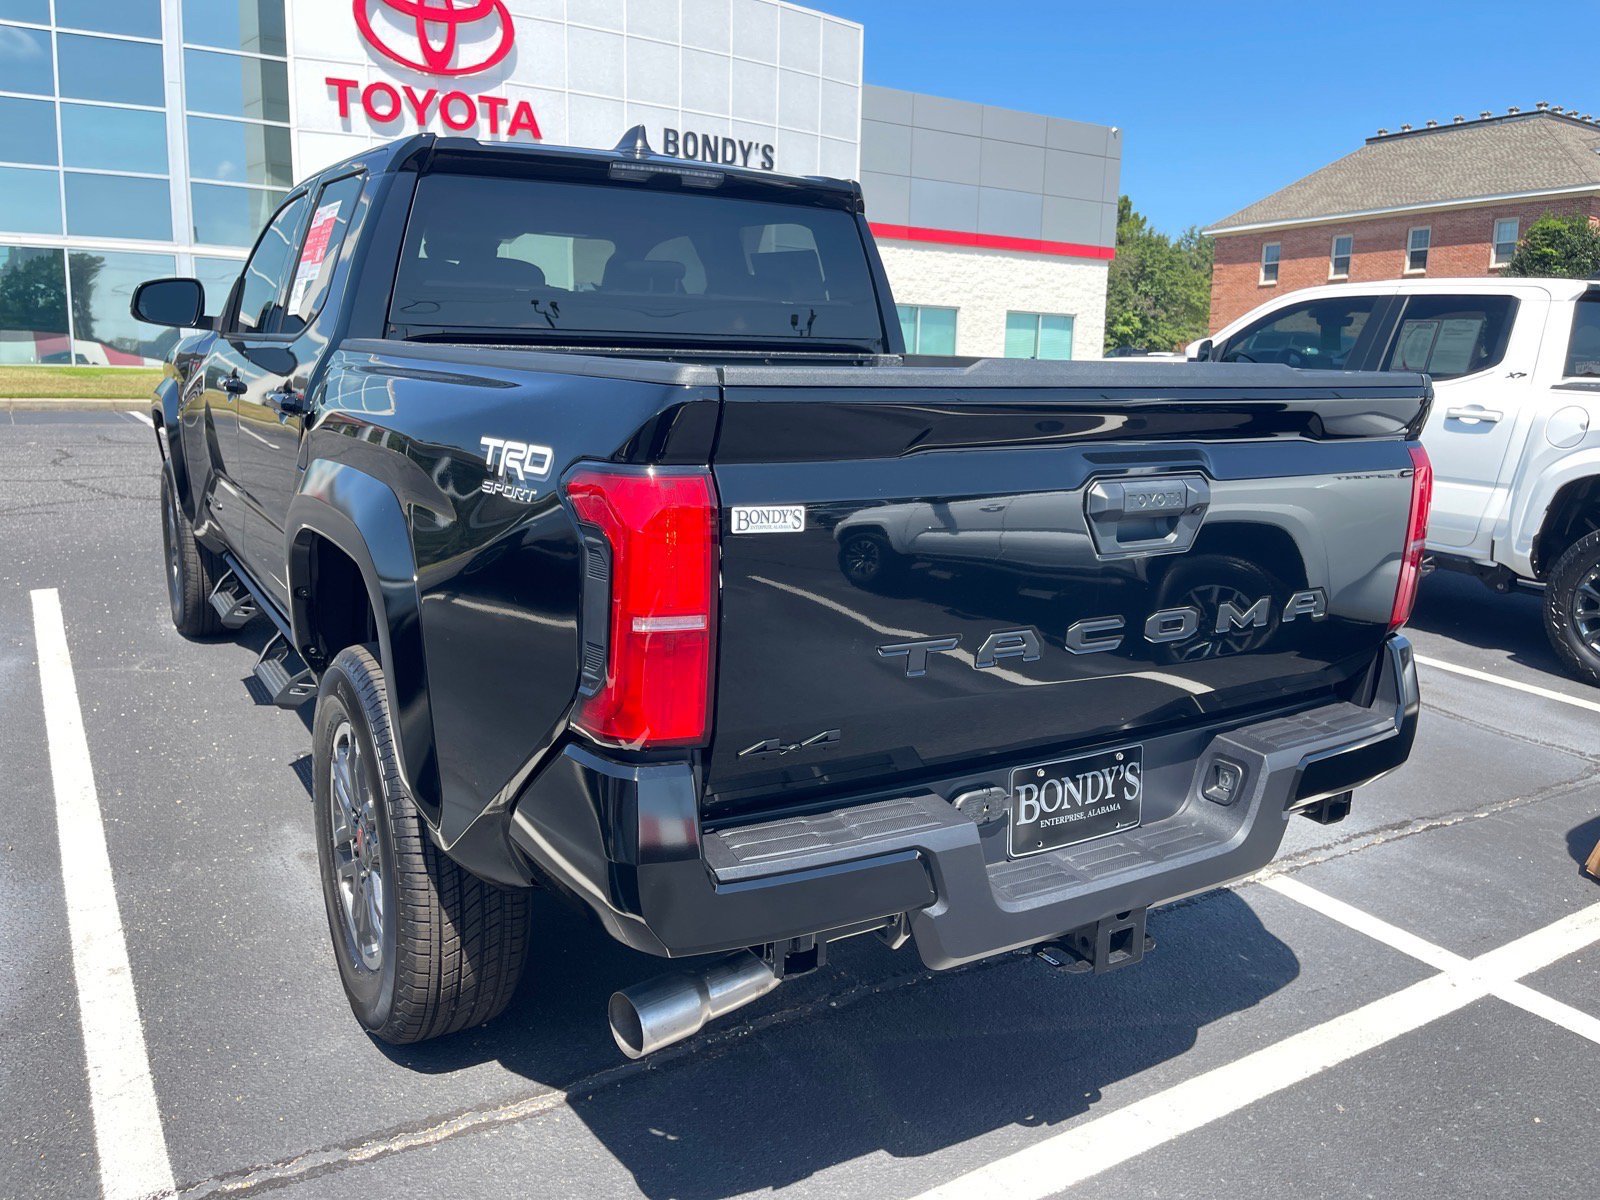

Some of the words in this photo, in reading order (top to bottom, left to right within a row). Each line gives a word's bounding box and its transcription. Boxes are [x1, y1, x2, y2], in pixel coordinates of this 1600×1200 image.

[325, 77, 543, 140] TOYOTA
[663, 127, 775, 171] BONDY'S
[480, 436, 554, 481] TRD
[481, 480, 538, 503] SPORT
[1127, 491, 1184, 508] TOYOTA
[734, 509, 802, 531] BONDY'S
[876, 587, 1328, 677] TACOMA
[1015, 761, 1140, 826] BONDY'S
[1040, 811, 1087, 828] ENTERPRISE,
[1087, 802, 1121, 818] ALABAMA
